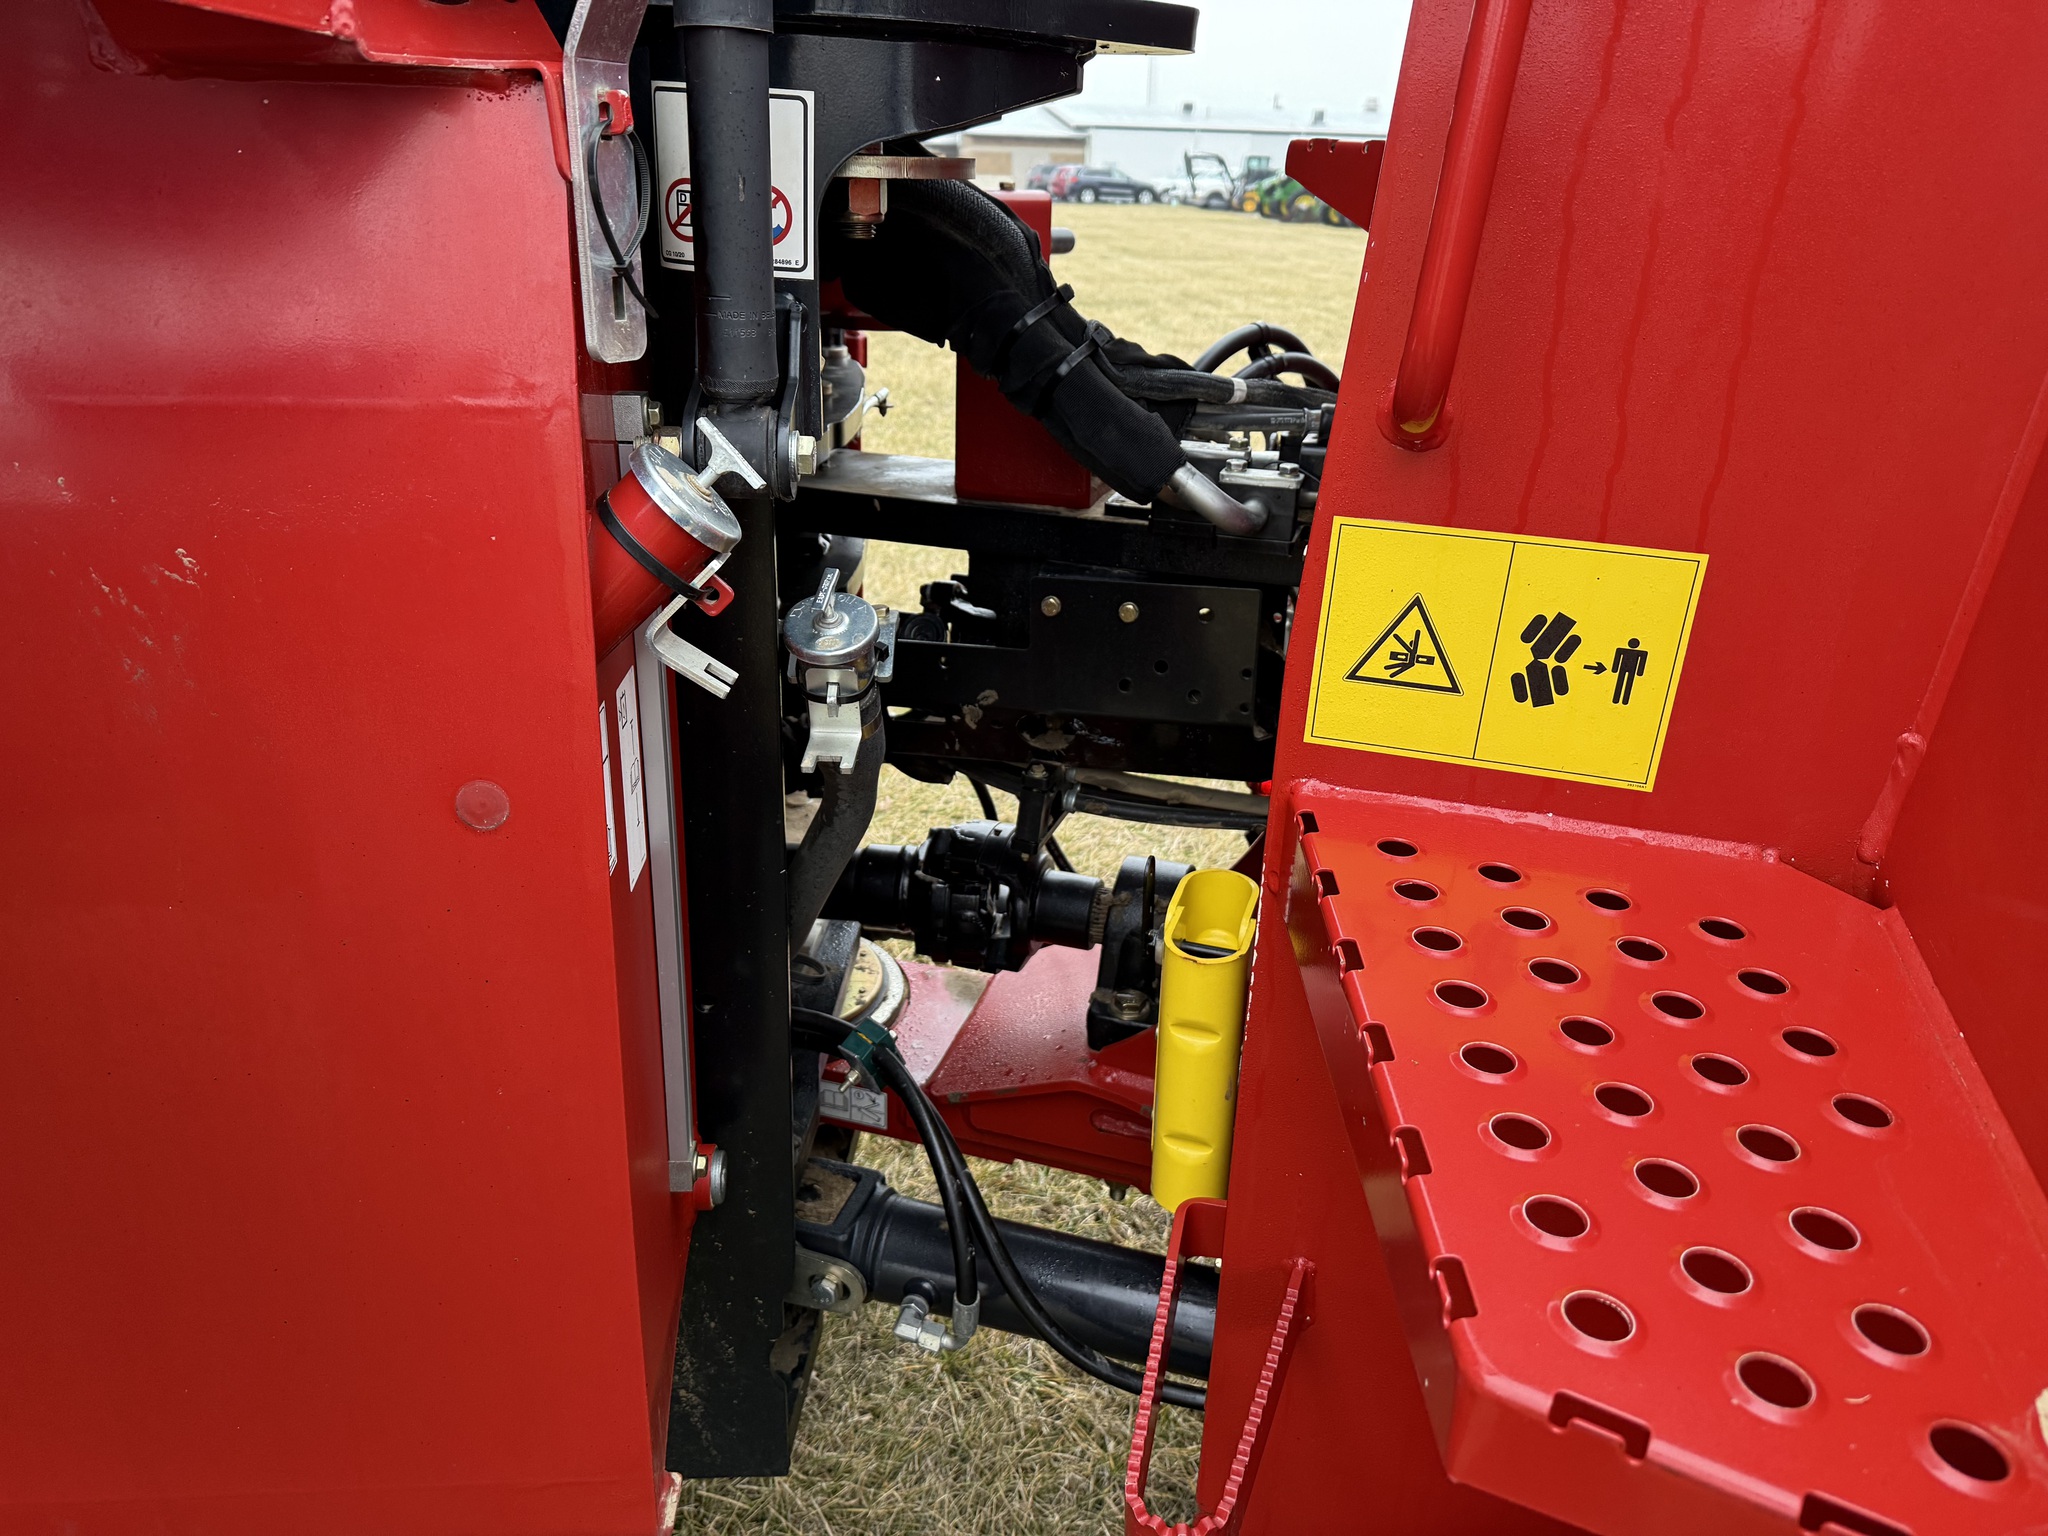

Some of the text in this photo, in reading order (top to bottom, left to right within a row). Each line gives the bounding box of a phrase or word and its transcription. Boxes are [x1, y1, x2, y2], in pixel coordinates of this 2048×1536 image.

[772, 258, 793, 266] 84896
[718, 311, 746, 321] MADE
[749, 311, 759, 321] IN
